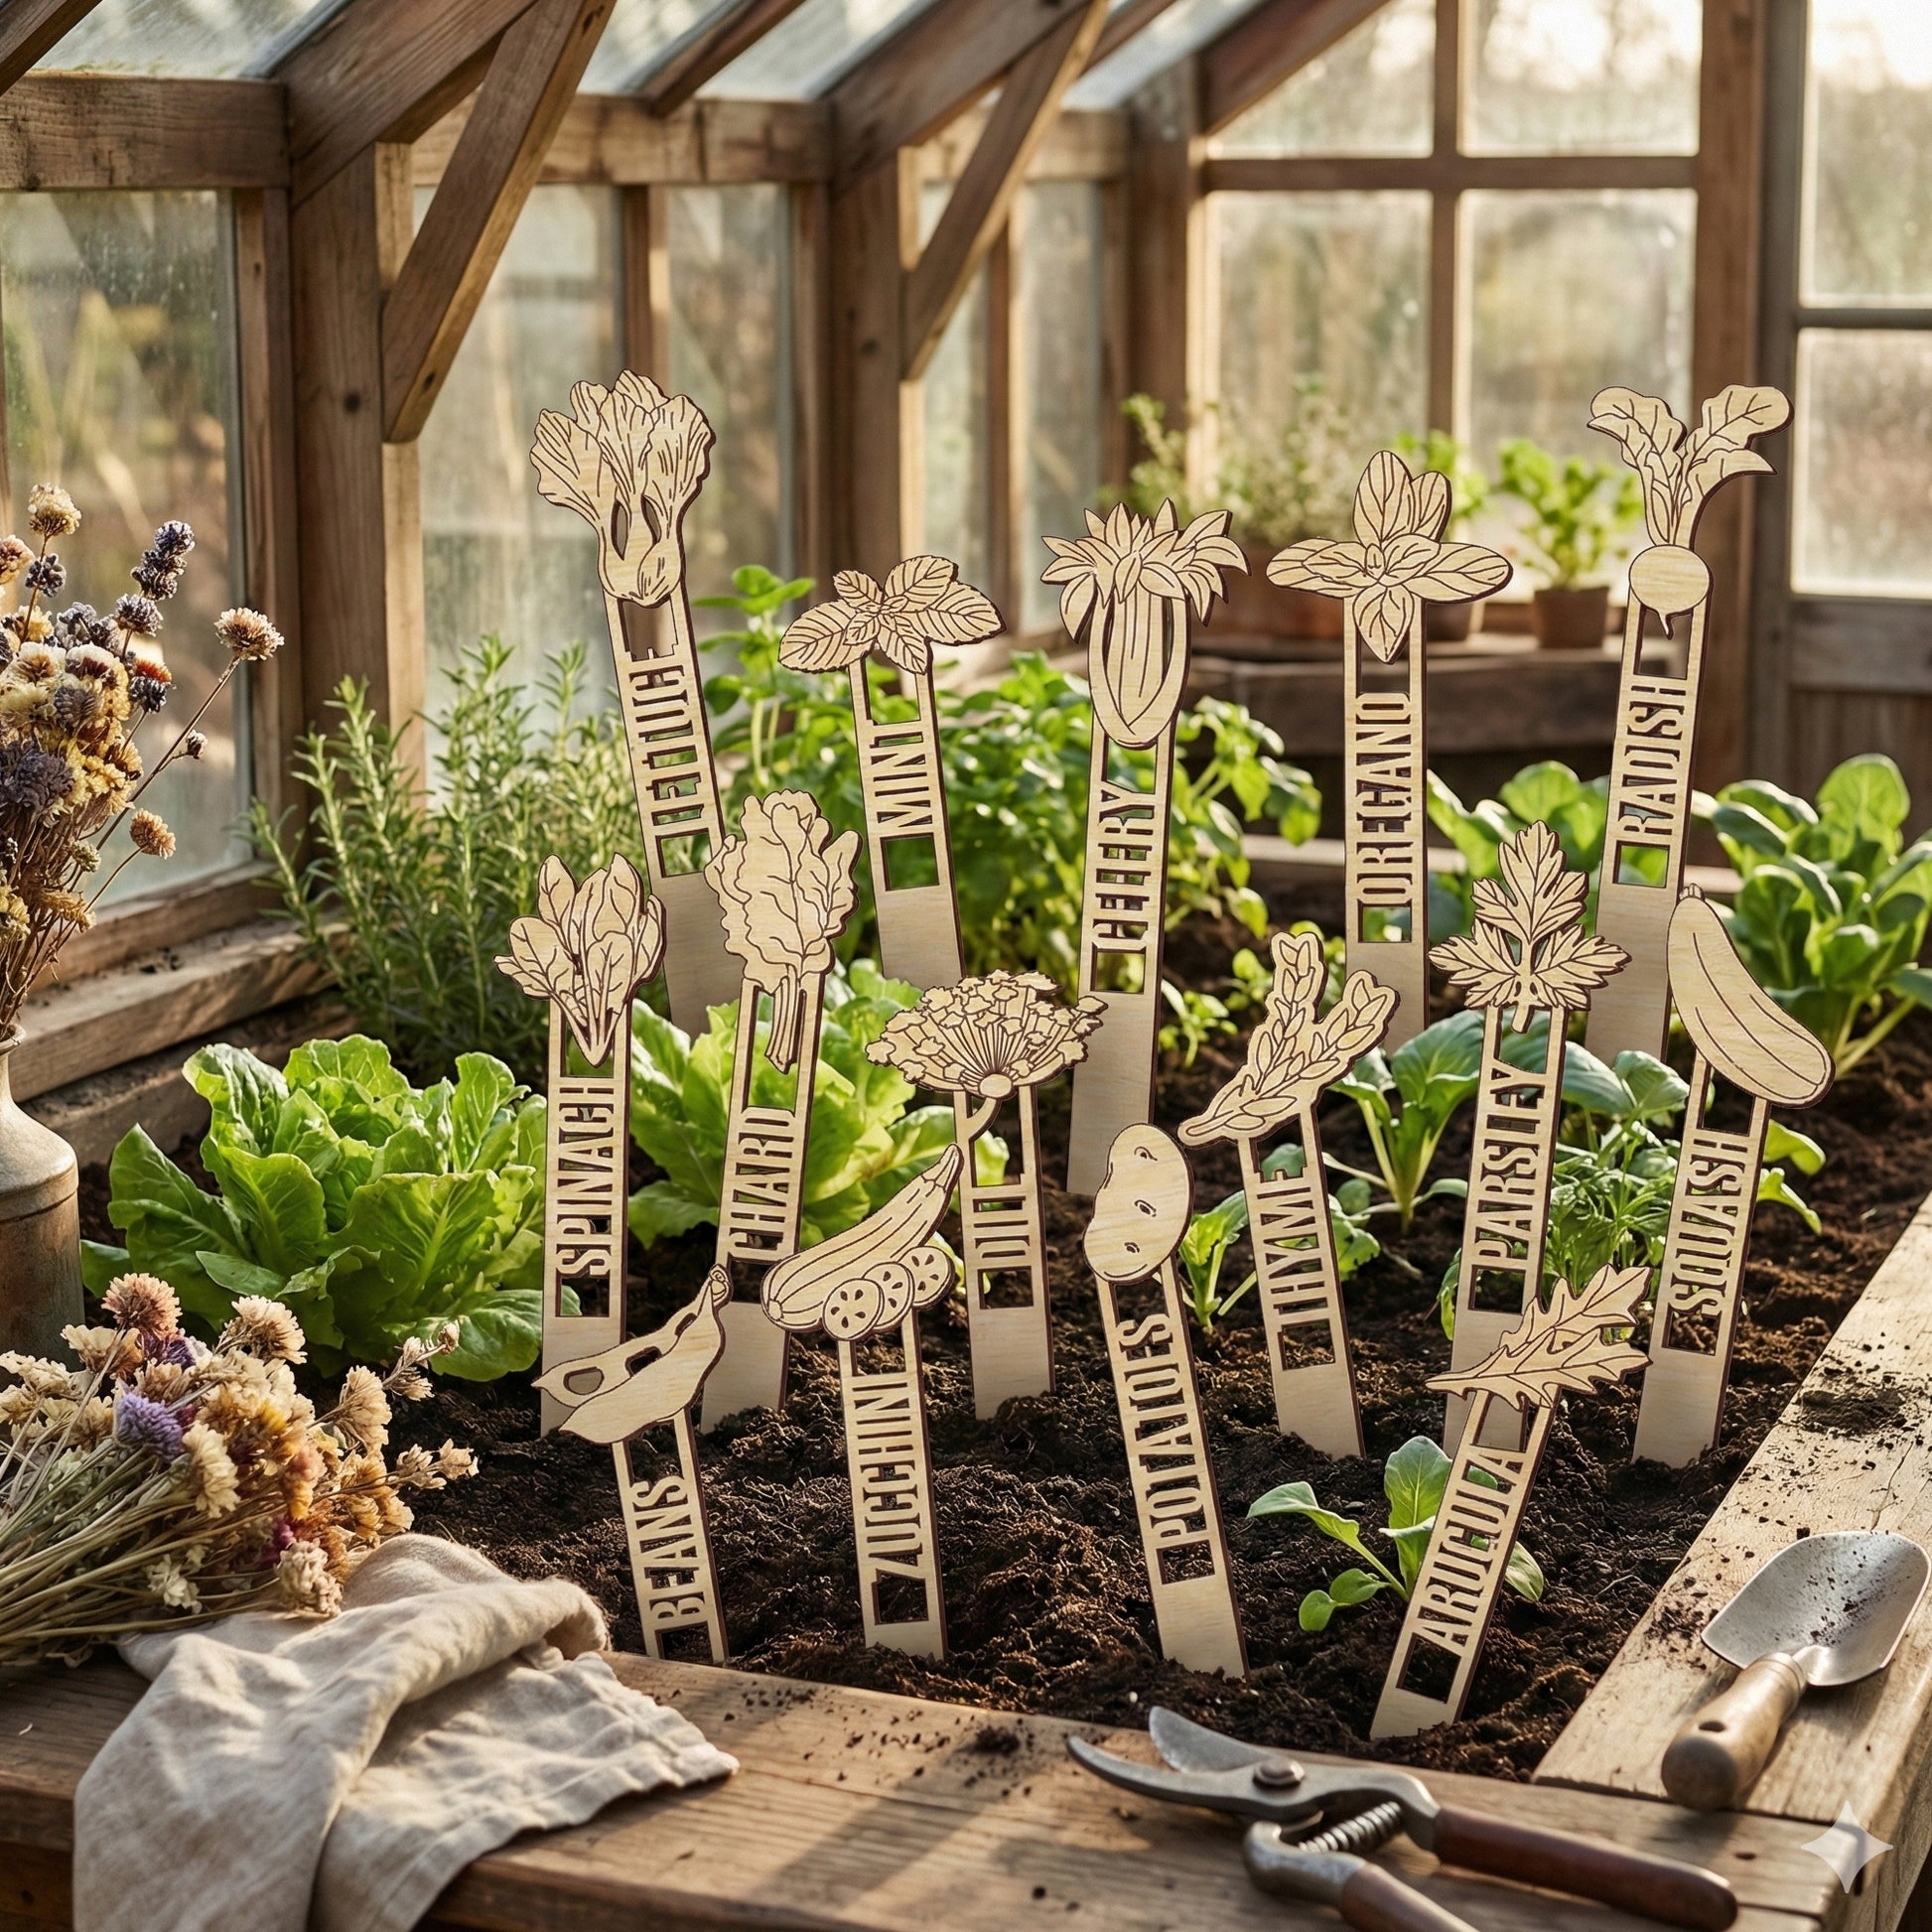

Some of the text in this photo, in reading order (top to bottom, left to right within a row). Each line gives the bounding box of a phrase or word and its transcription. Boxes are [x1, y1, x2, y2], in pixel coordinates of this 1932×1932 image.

[867, 719, 933, 837] MINT
[1355, 692, 1413, 904] OREGANO
[1617, 676, 1687, 844] RADISH
[556, 1078, 615, 1276] SPINACH
[728, 1106, 795, 1261] CHARD
[972, 1173, 1032, 1269] DILL
[1255, 1166, 1329, 1332] THYME
[1472, 1058, 1546, 1269] PARSLEY
[1668, 1130, 1749, 1316] SQUASH
[852, 1372, 925, 1583] ZUCCHINI
[1117, 1313, 1209, 1549] POTATOES
[630, 1476, 708, 1629] BEANS
